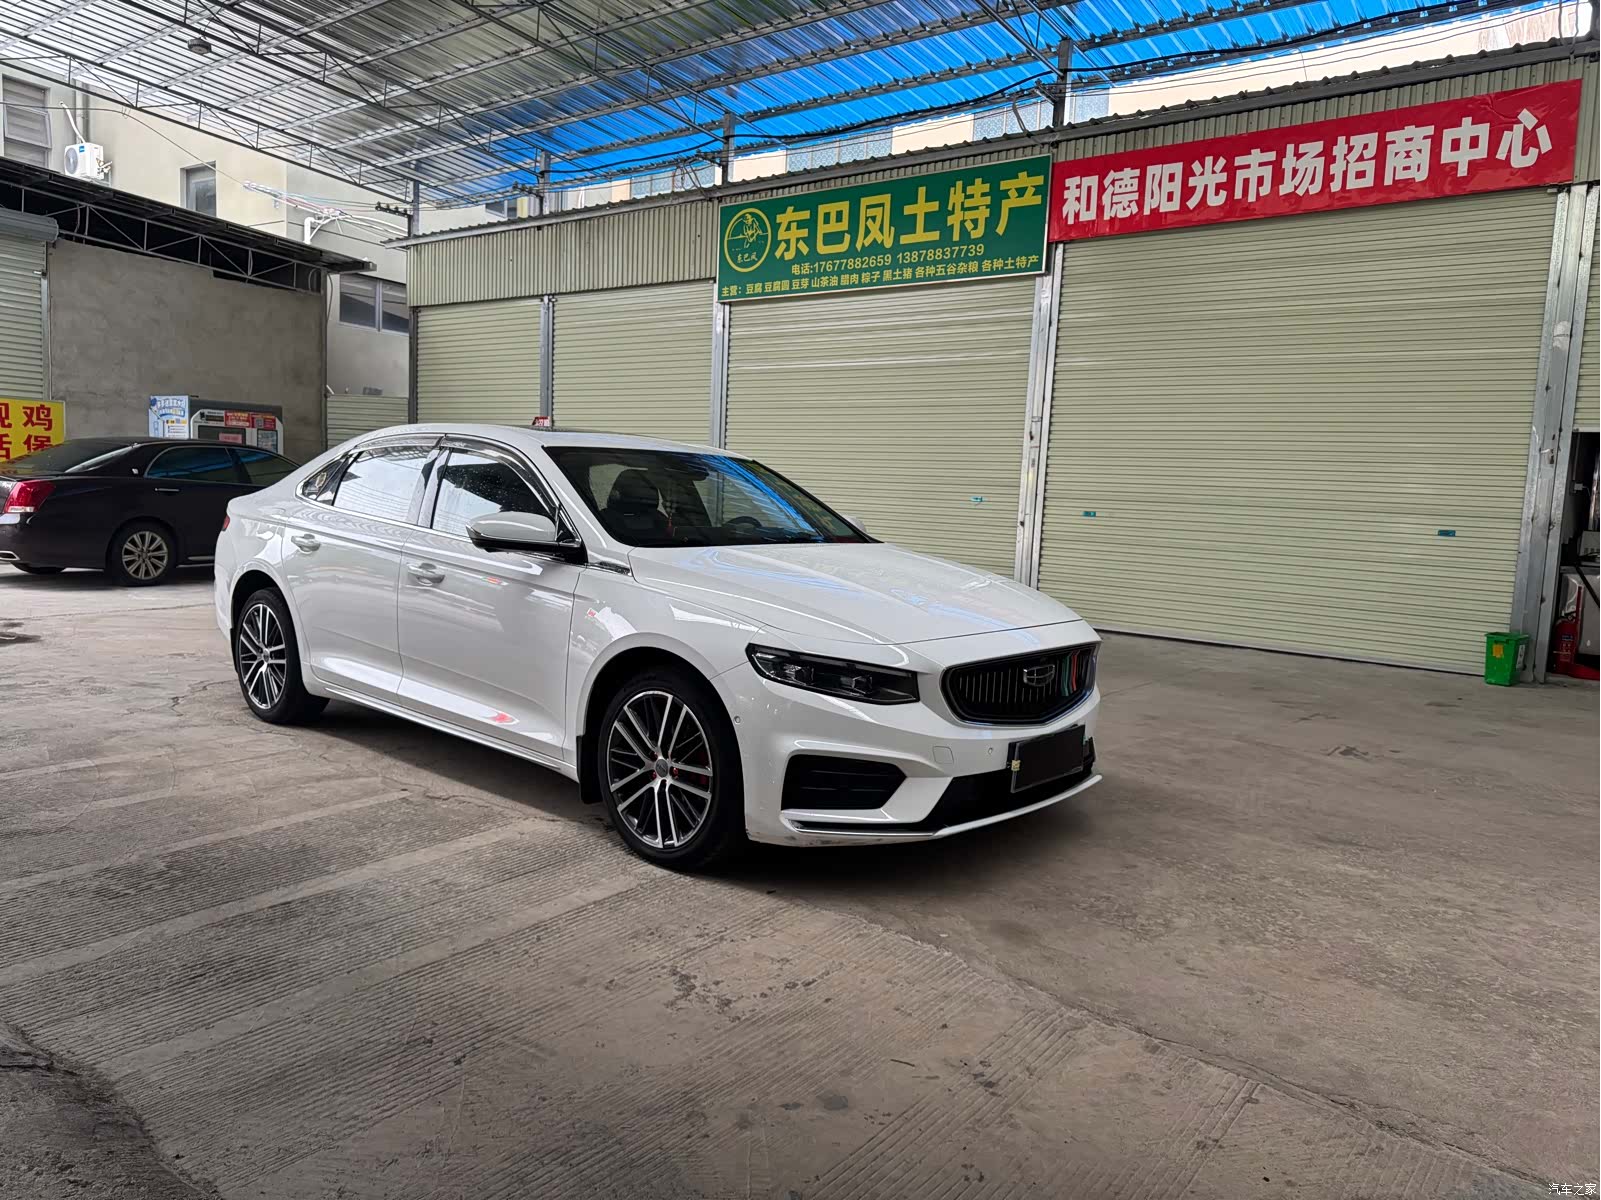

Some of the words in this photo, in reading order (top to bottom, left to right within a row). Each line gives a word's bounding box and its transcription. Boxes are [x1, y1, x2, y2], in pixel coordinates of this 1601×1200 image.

[1062, 108, 1552, 225] 和德阳光市场招商中心
[774, 171, 1045, 261] 东巴凤土特产
[811, 275, 839, 288] 山茶油
[883, 267, 912, 282] 黑土猪
[915, 260, 979, 278] 各种五谷杂粮
[981, 254, 1040, 272] 各种土特产
[897, 243, 985, 264] 13878837739
